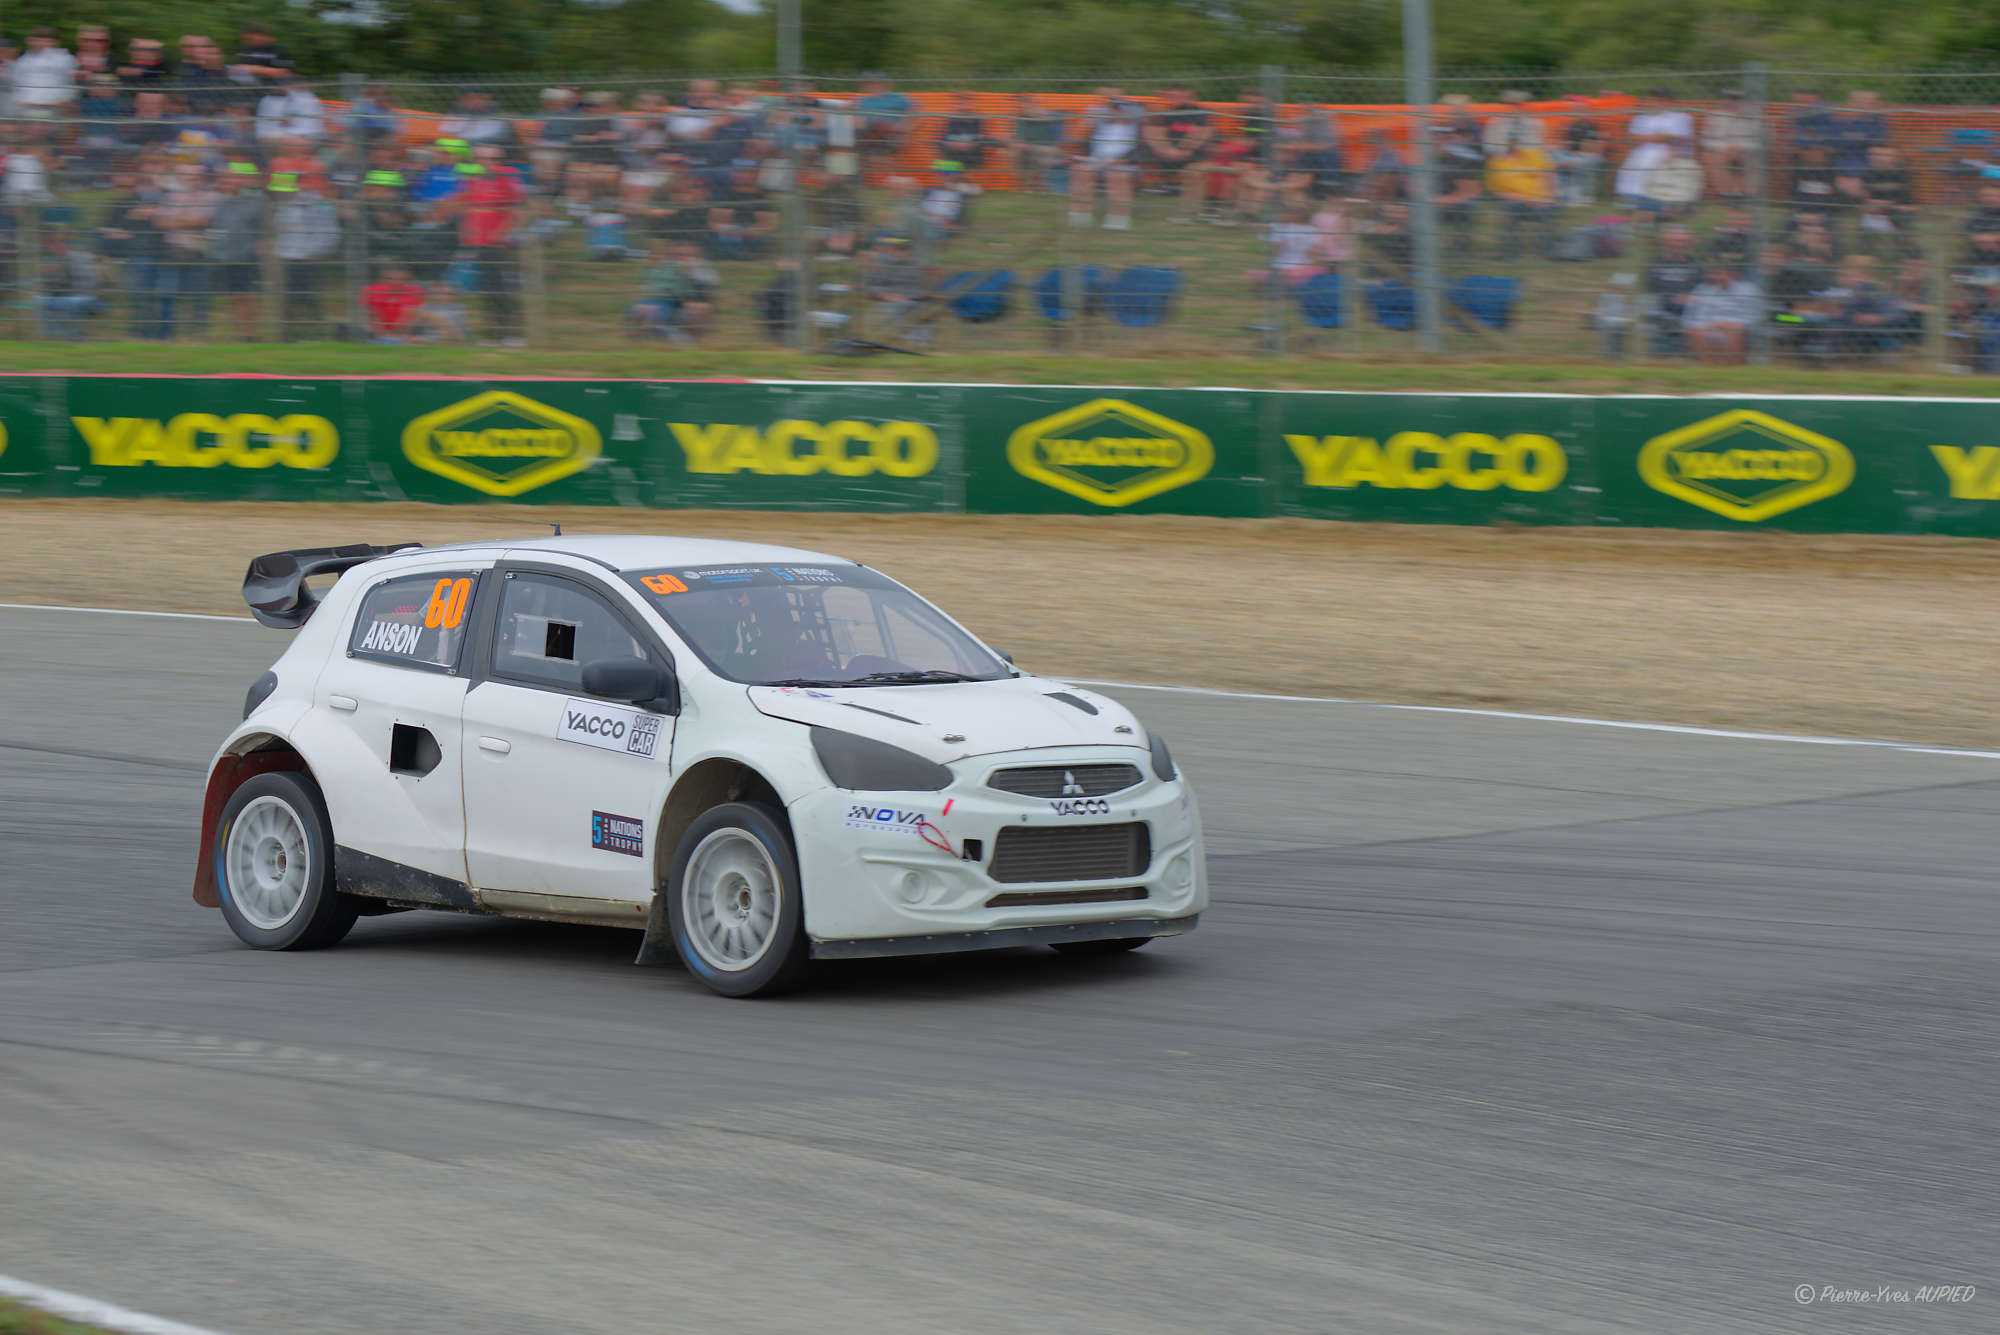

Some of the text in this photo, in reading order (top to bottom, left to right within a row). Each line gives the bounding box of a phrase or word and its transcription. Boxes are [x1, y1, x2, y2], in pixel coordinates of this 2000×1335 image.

[72, 413, 340, 469] YACCO
[429, 428, 572, 459] YACCO
[667, 419, 940, 478] YACCO
[1038, 436, 1187, 468] YACCO
[1283, 431, 1568, 492] YACCO
[1669, 449, 1826, 481] YACCO
[640, 575, 688, 594] 60
[425, 577, 472, 629] 60
[361, 621, 423, 655] ANSON
[567, 711, 625, 739] YACCO
[633, 715, 660, 733] SUPER
[630, 732, 654, 755] CAR
[1050, 800, 1109, 816] YACCO
[593, 816, 602, 843] 5
[610, 819, 641, 838] NATIONS
[610, 837, 641, 852] TROPHY
